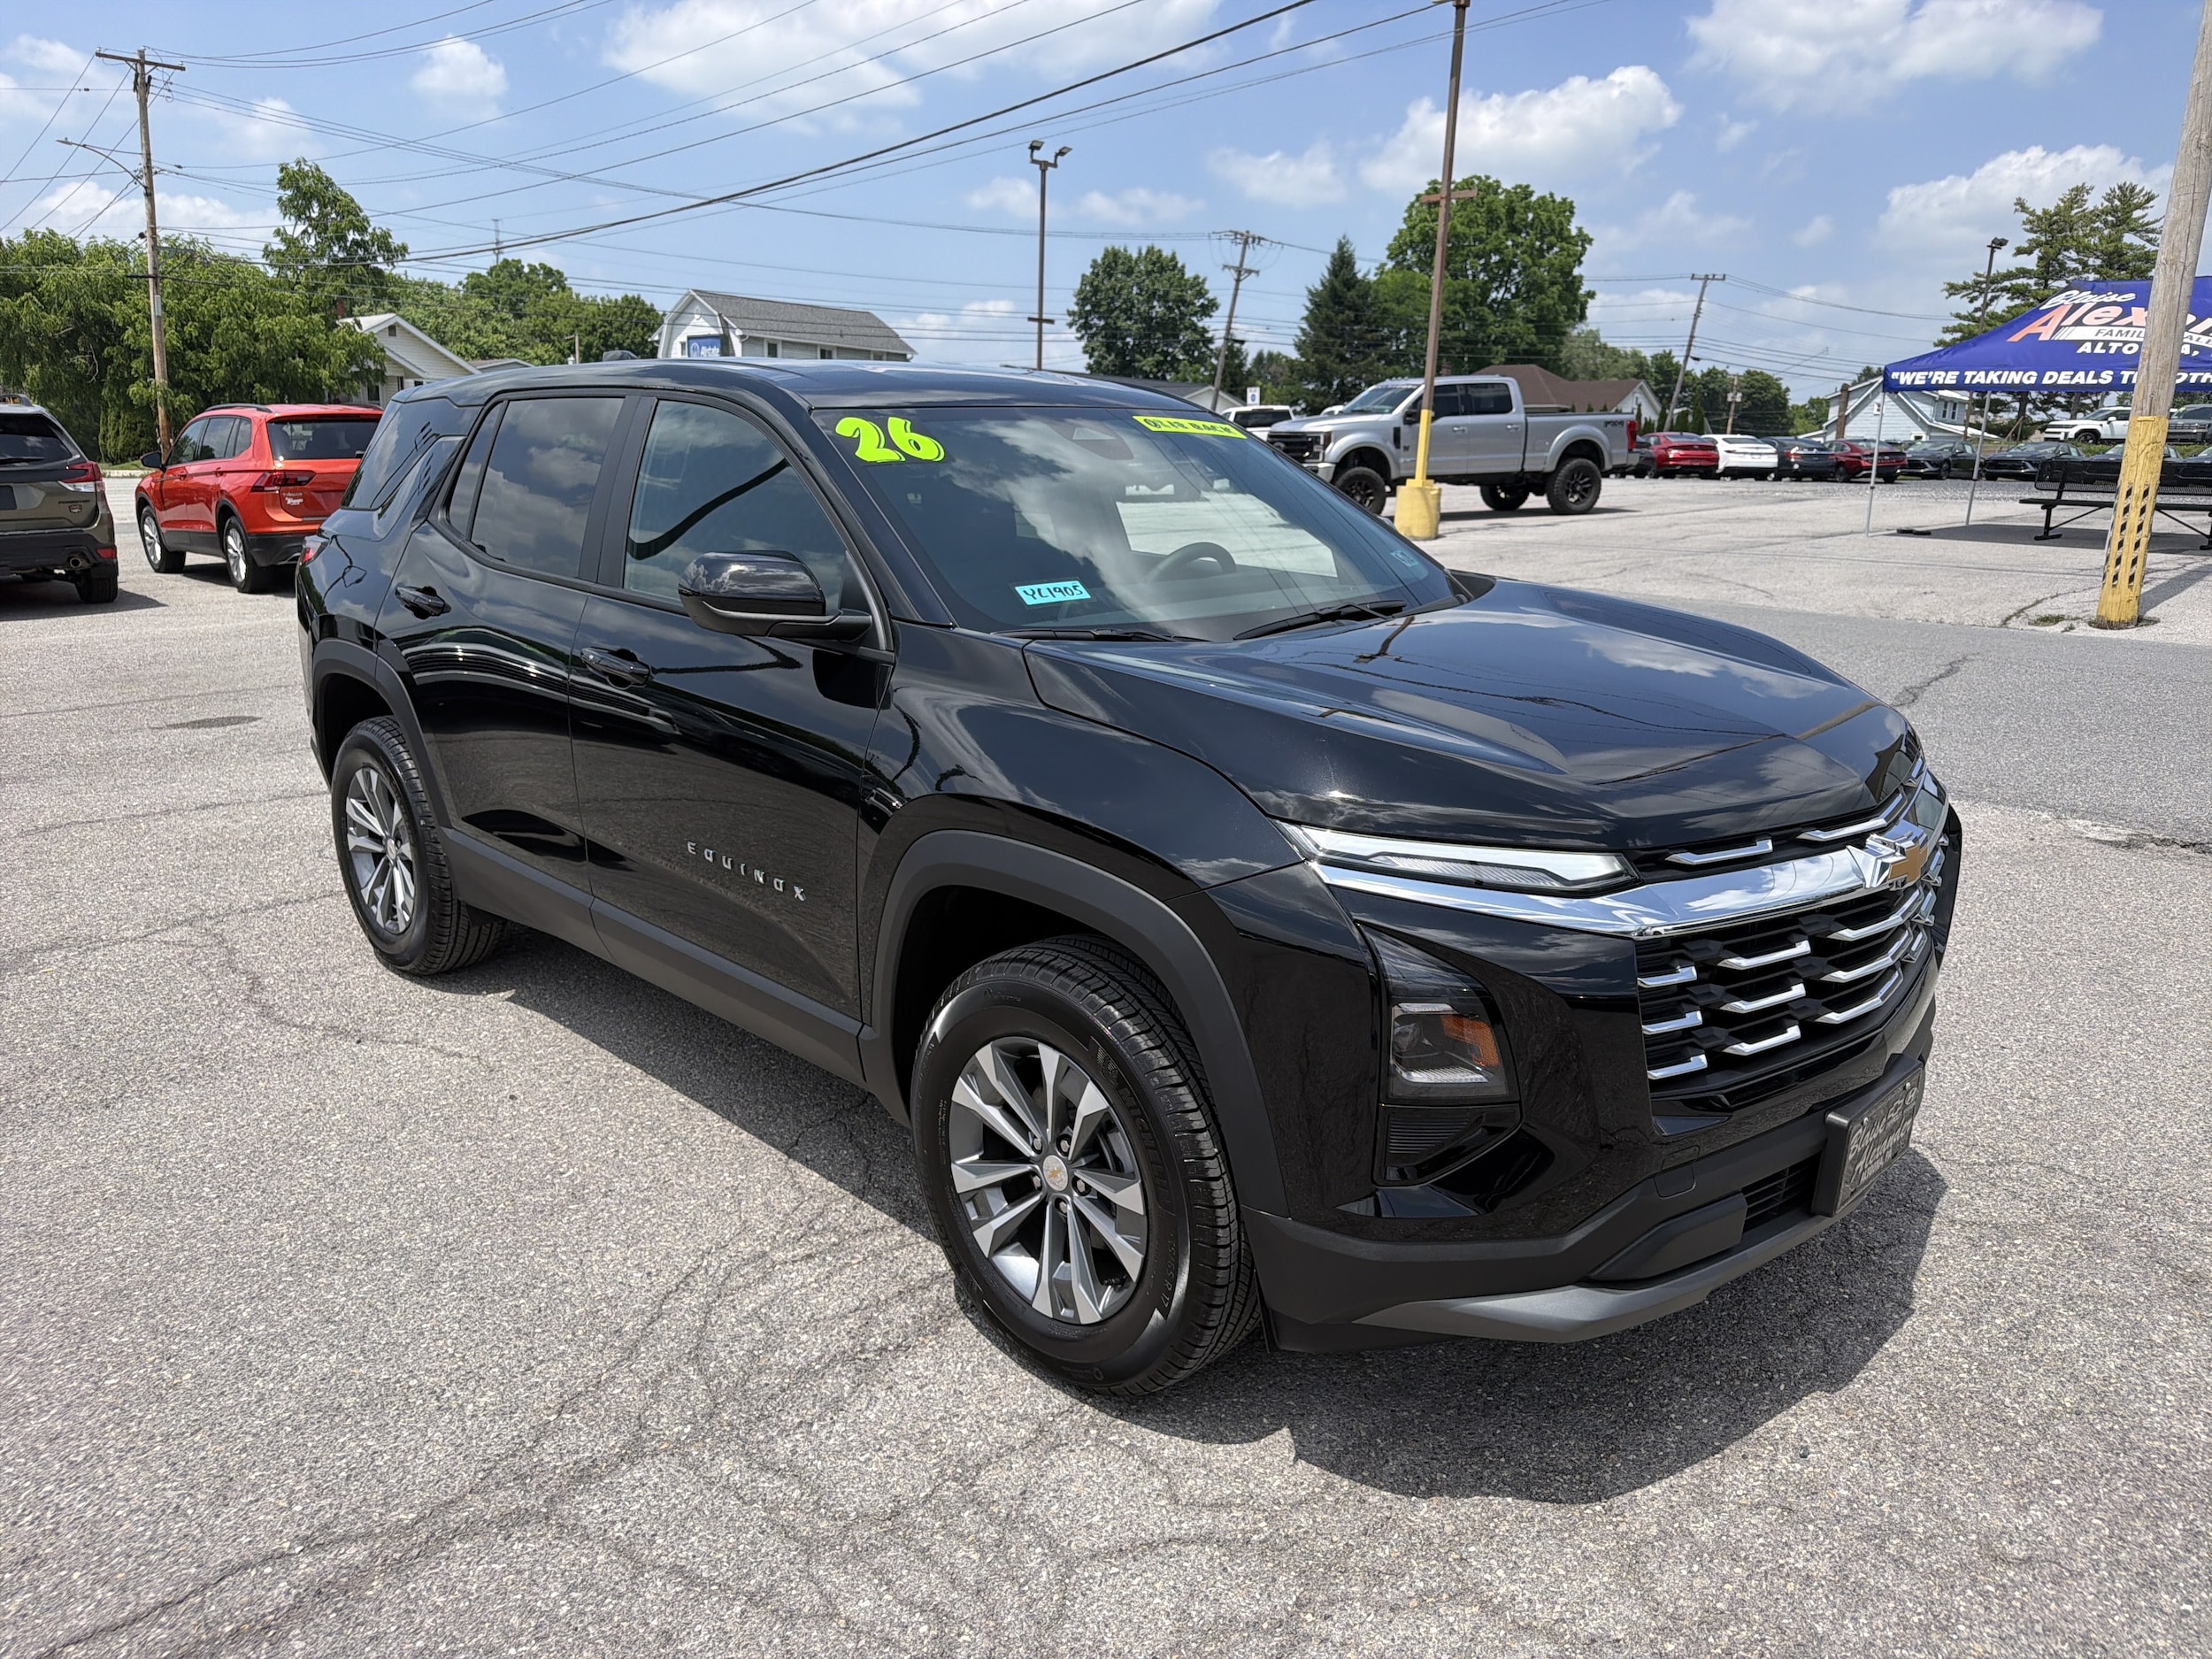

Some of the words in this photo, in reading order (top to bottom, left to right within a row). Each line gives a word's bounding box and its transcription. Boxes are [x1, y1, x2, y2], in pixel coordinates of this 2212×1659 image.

[2039, 289, 2136, 310] Blaise
[2094, 328, 2145, 339] FAMIL
[1963, 371, 2038, 385] TAKING
[2041, 371, 2113, 385] DEALS
[835, 417, 945, 462] 26
[687, 841, 806, 902] EQUINOX
